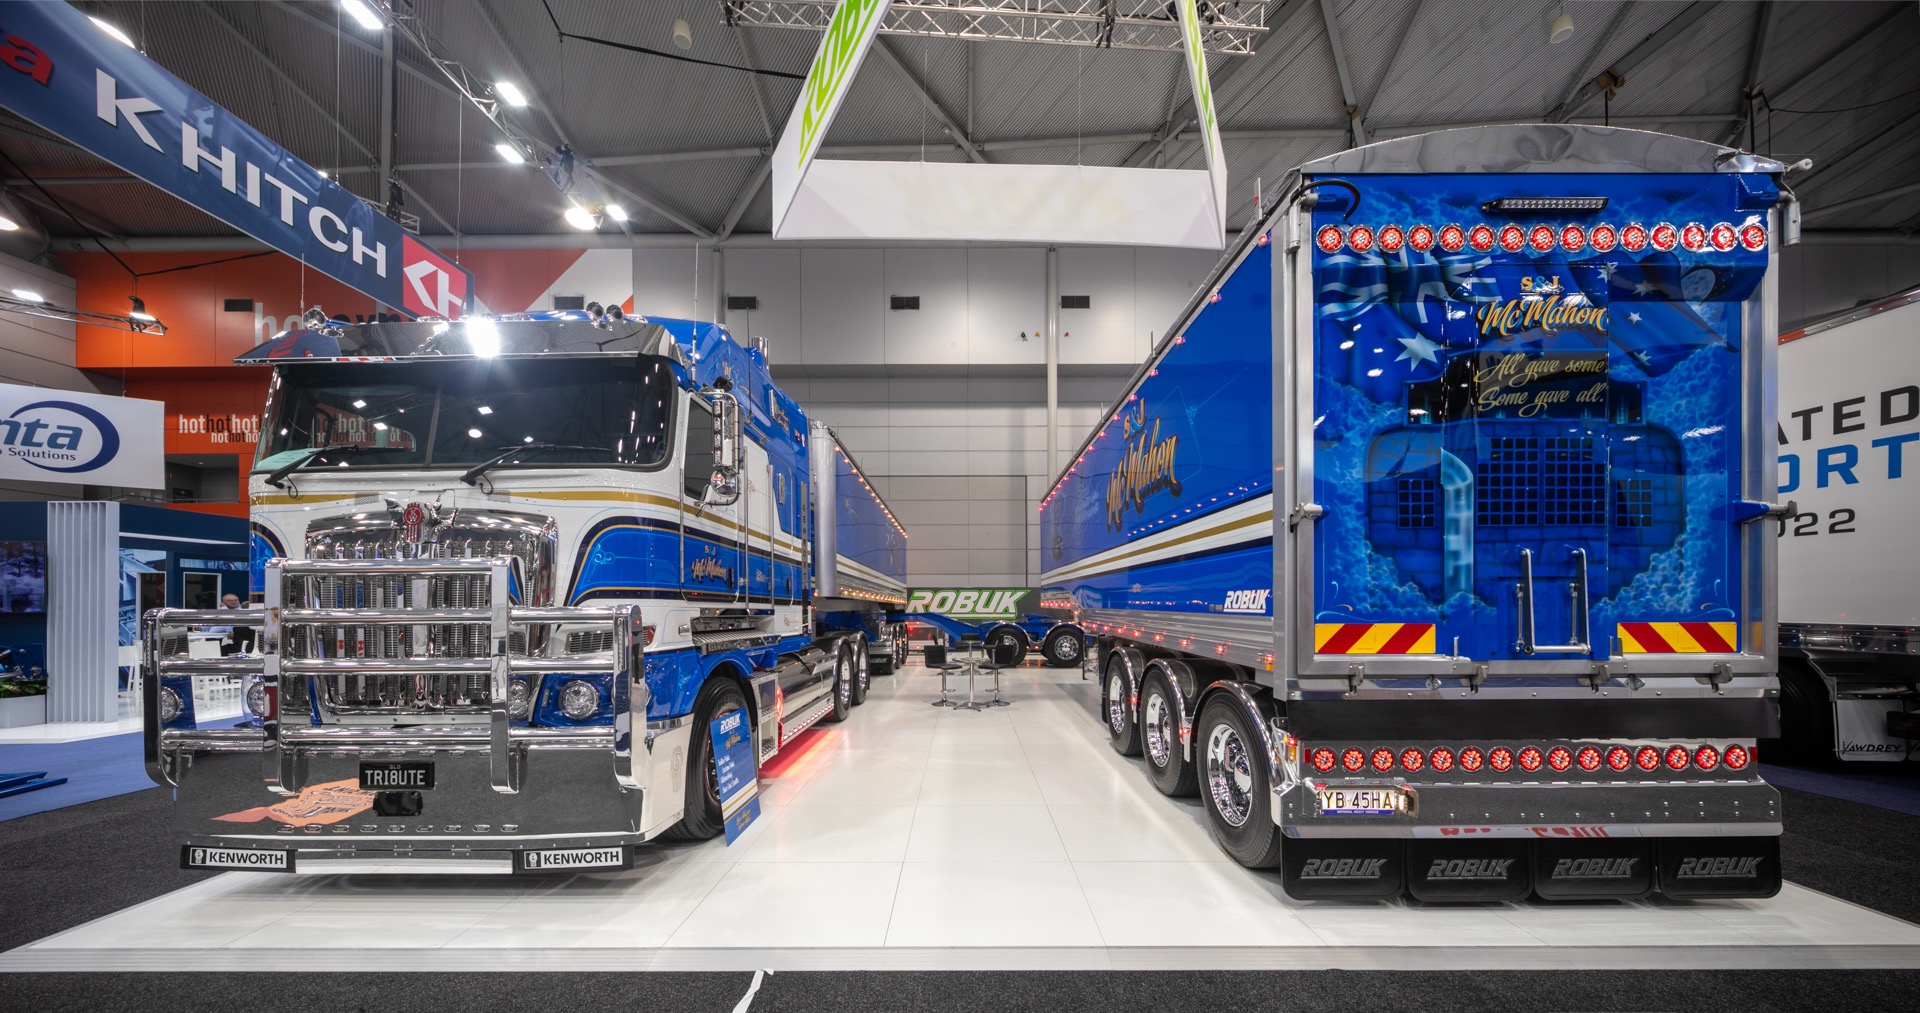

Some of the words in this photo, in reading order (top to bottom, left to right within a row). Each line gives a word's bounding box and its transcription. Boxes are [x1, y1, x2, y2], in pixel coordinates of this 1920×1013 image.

[96, 68, 163, 153] K
[182, 122, 387, 279] HITCH
[1474, 353, 1525, 382] All
[1509, 359, 1559, 387] gave
[1478, 386, 1529, 411] Some
[1518, 390, 1570, 417] gave
[8, 447, 76, 461] Solutions
[904, 590, 1030, 615] ROBUK
[1223, 589, 1270, 611] ROBUK
[209, 851, 284, 865] KENWORTH
[543, 851, 620, 865] KENWORTH
[1300, 858, 1388, 877] ROBUK
[1427, 858, 1516, 877] ROBUK
[1552, 857, 1640, 877] ROBUK
[1677, 857, 1766, 876] ROBUK
